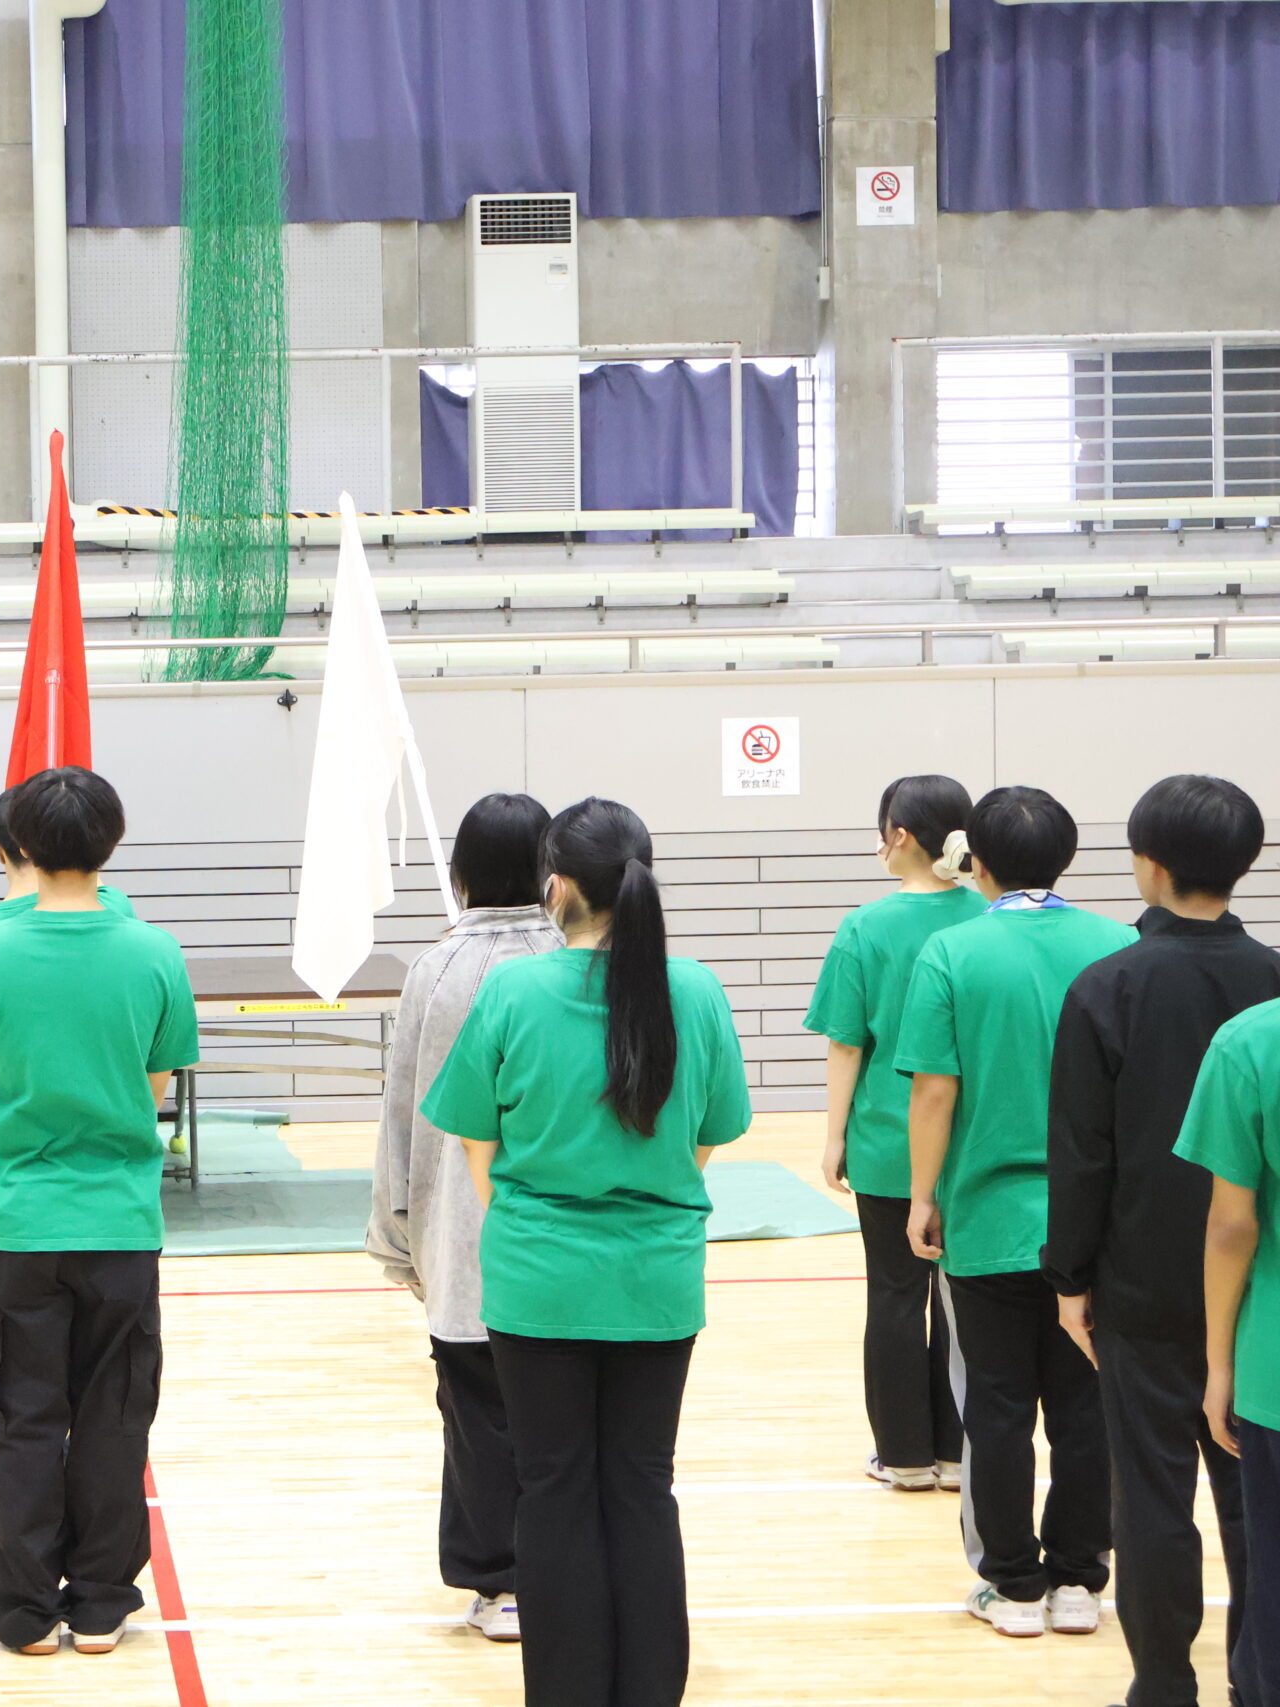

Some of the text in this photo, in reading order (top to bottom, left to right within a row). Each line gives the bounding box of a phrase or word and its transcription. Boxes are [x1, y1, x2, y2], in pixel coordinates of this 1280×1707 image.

[737, 768, 785, 779] アリーナ内
[741, 779, 781, 789] 飲食禁止
